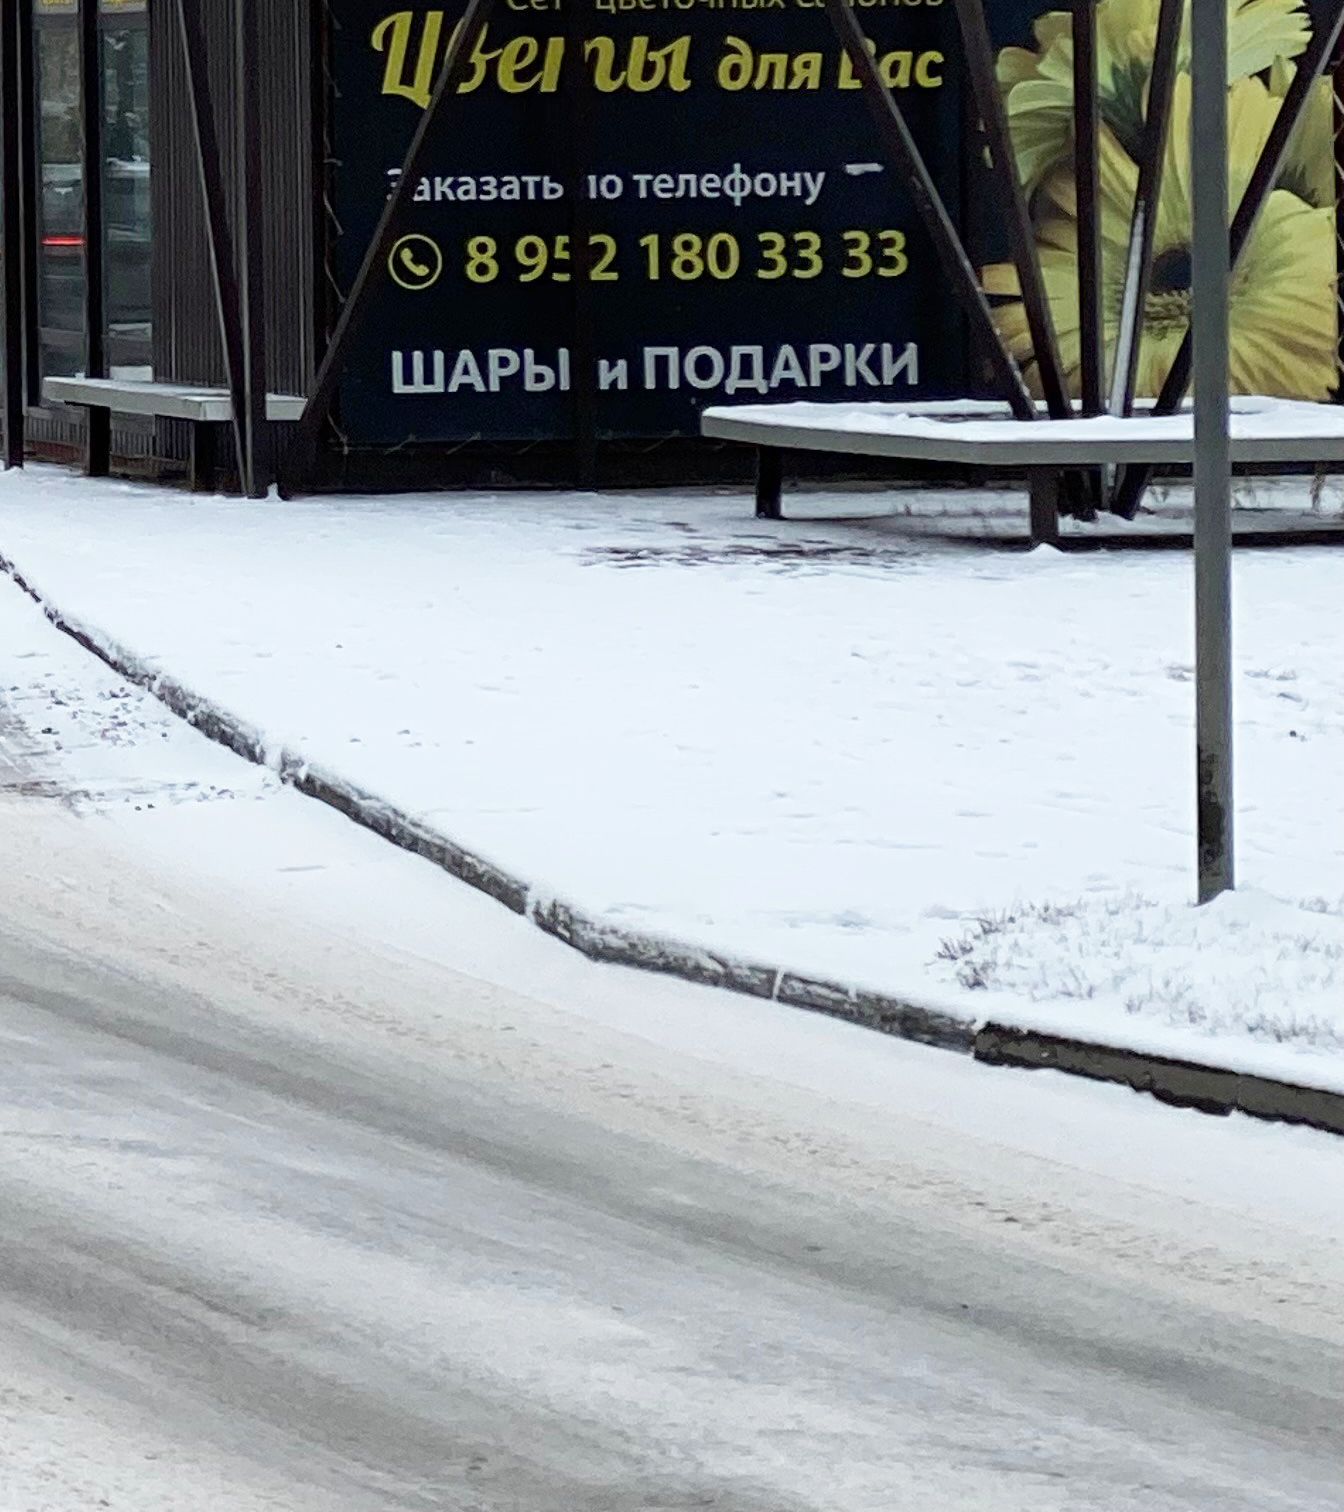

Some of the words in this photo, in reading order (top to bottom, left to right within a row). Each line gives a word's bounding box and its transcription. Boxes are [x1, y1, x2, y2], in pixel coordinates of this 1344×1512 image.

[718, 35, 823, 91] для
[632, 162, 826, 206] телефону
[465, 235, 499, 283] 8
[639, 232, 740, 280] 180
[756, 231, 823, 279] 33
[841, 229, 908, 277] 33
[391, 347, 570, 393] ШАРЫ
[597, 358, 628, 390] и
[643, 342, 919, 395] ПОДАРКИ
